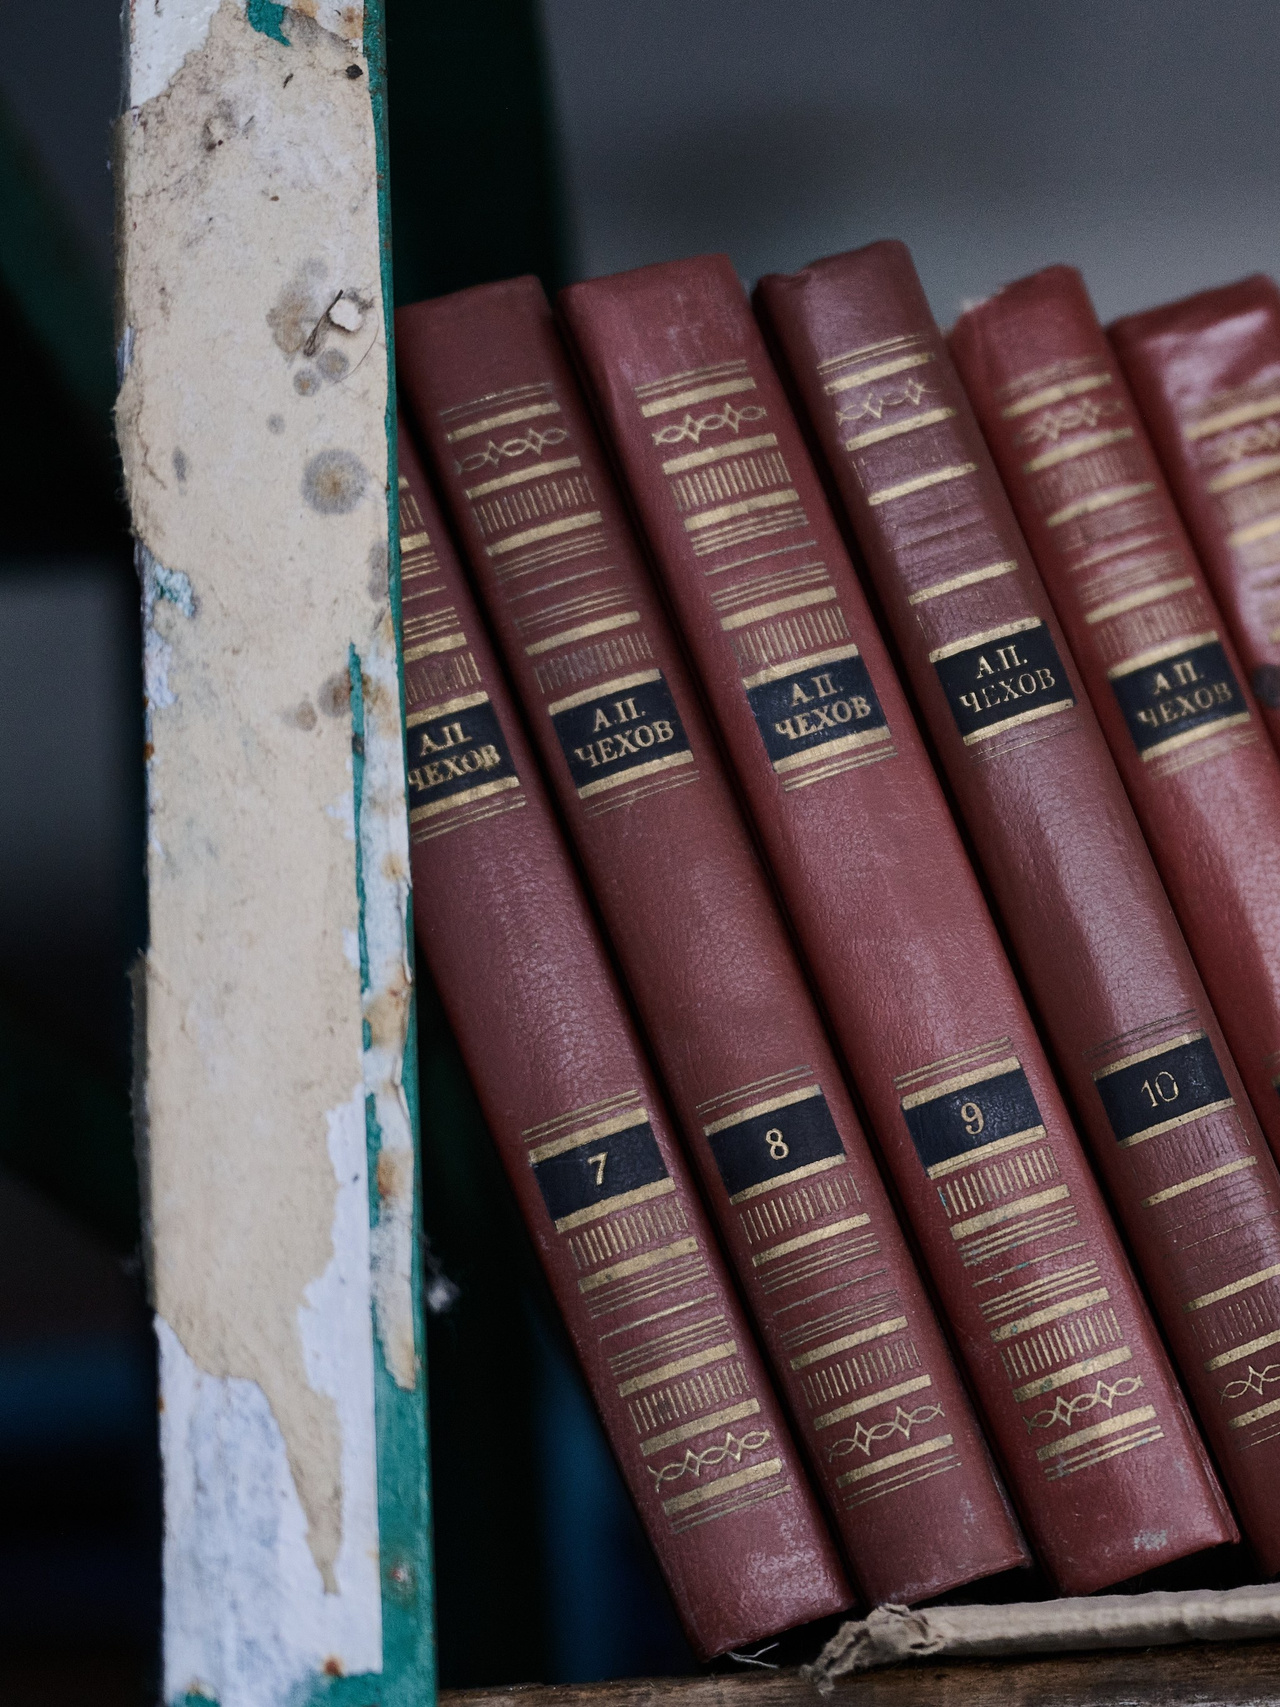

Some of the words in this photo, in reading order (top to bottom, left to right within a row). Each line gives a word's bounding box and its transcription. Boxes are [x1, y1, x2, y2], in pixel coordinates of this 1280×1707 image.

[959, 667, 1056, 714] ЧЕХОВ
[1137, 681, 1232, 728] ЧЕХОВ
[775, 696, 871, 741] ЧЕХОВ
[408, 744, 501, 791] ЧЕХОВ
[574, 722, 674, 769] ЧЕХОВ
[1140, 1070, 1180, 1109] 10
[961, 1102, 985, 1135] 9
[765, 1127, 789, 1160] 8
[587, 1152, 609, 1186] 7
